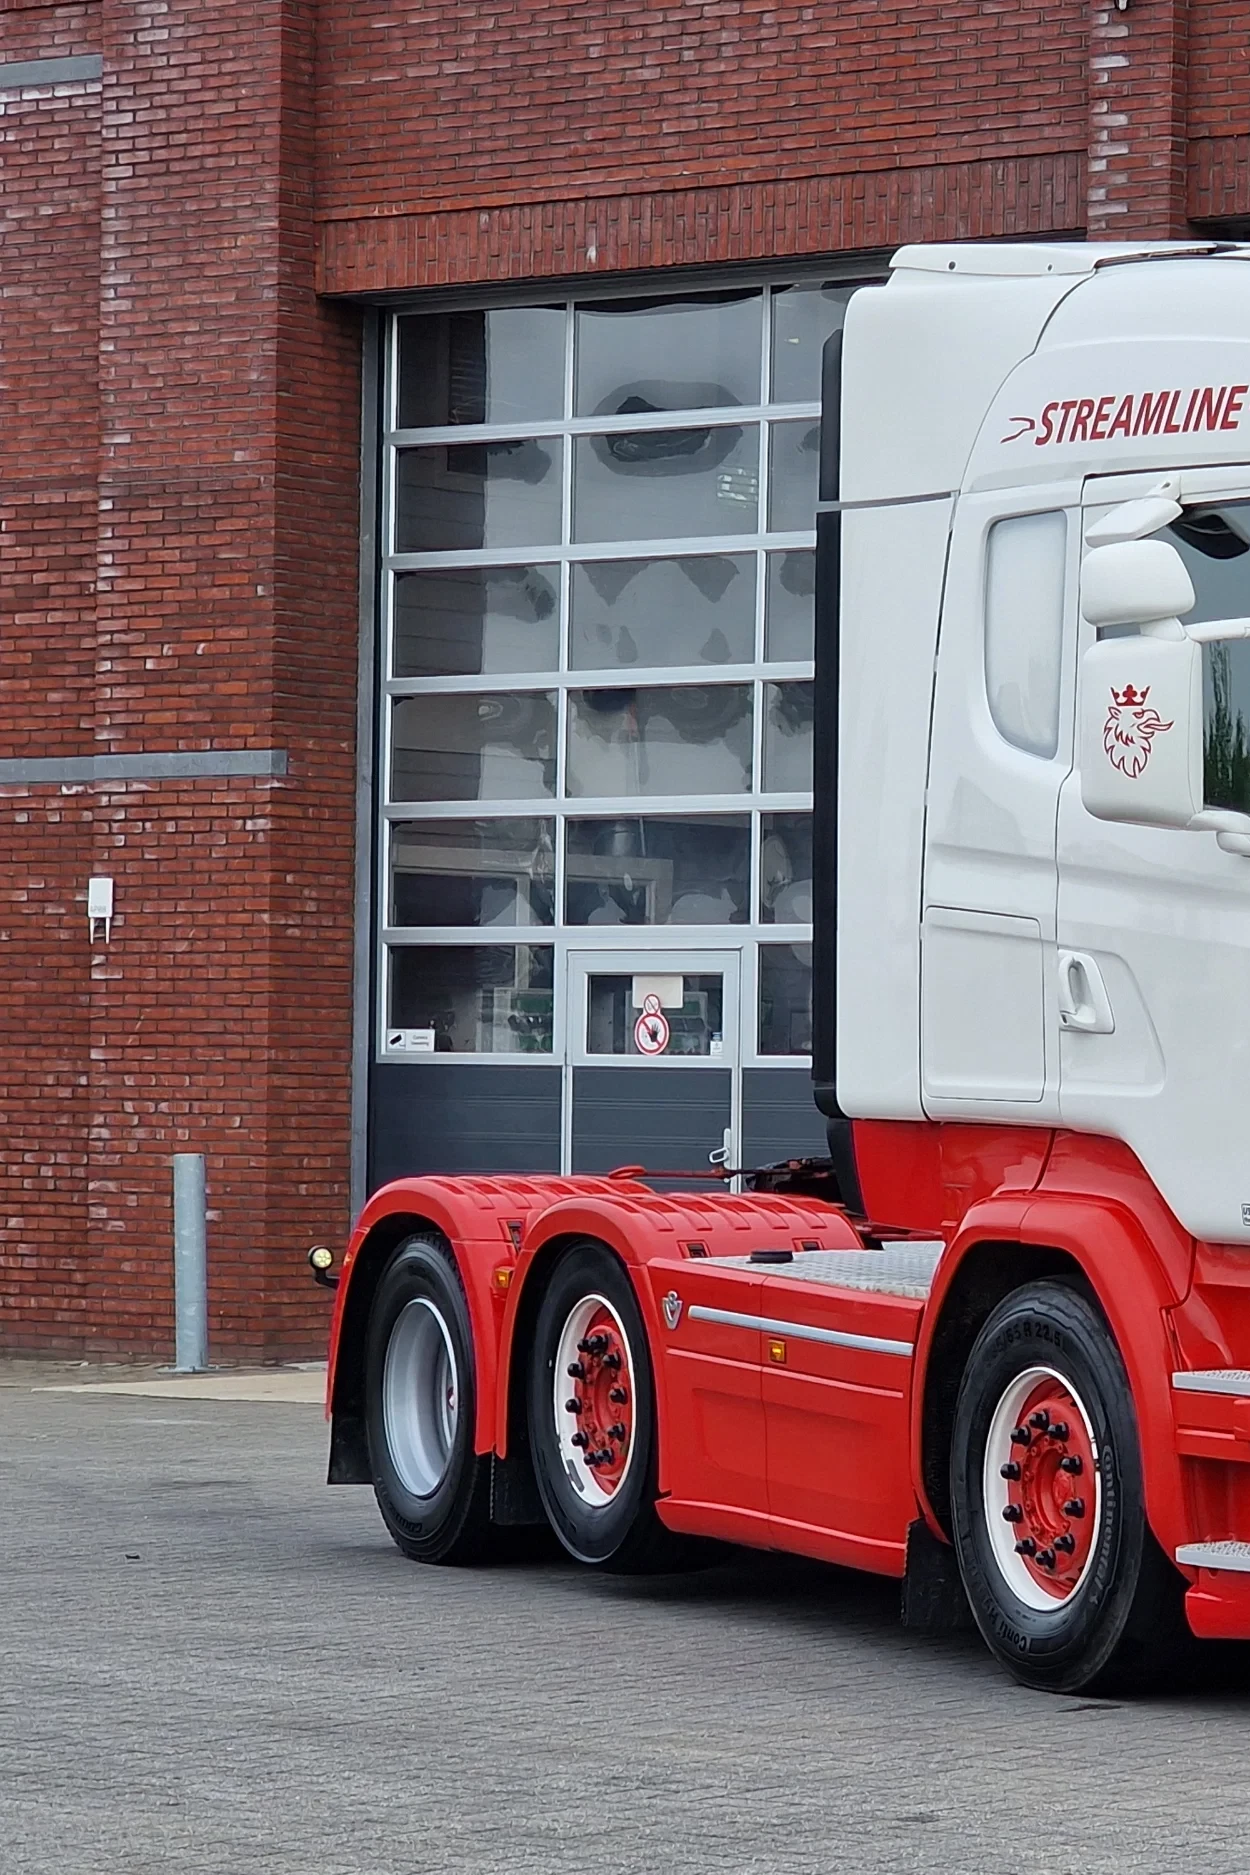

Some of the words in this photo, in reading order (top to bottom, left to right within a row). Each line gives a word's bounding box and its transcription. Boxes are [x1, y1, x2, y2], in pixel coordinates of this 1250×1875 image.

[1034, 384, 1249, 446] STREAMLINE
[1094, 1445, 1117, 1591] Continental
[996, 1621, 1028, 1652] Conti
